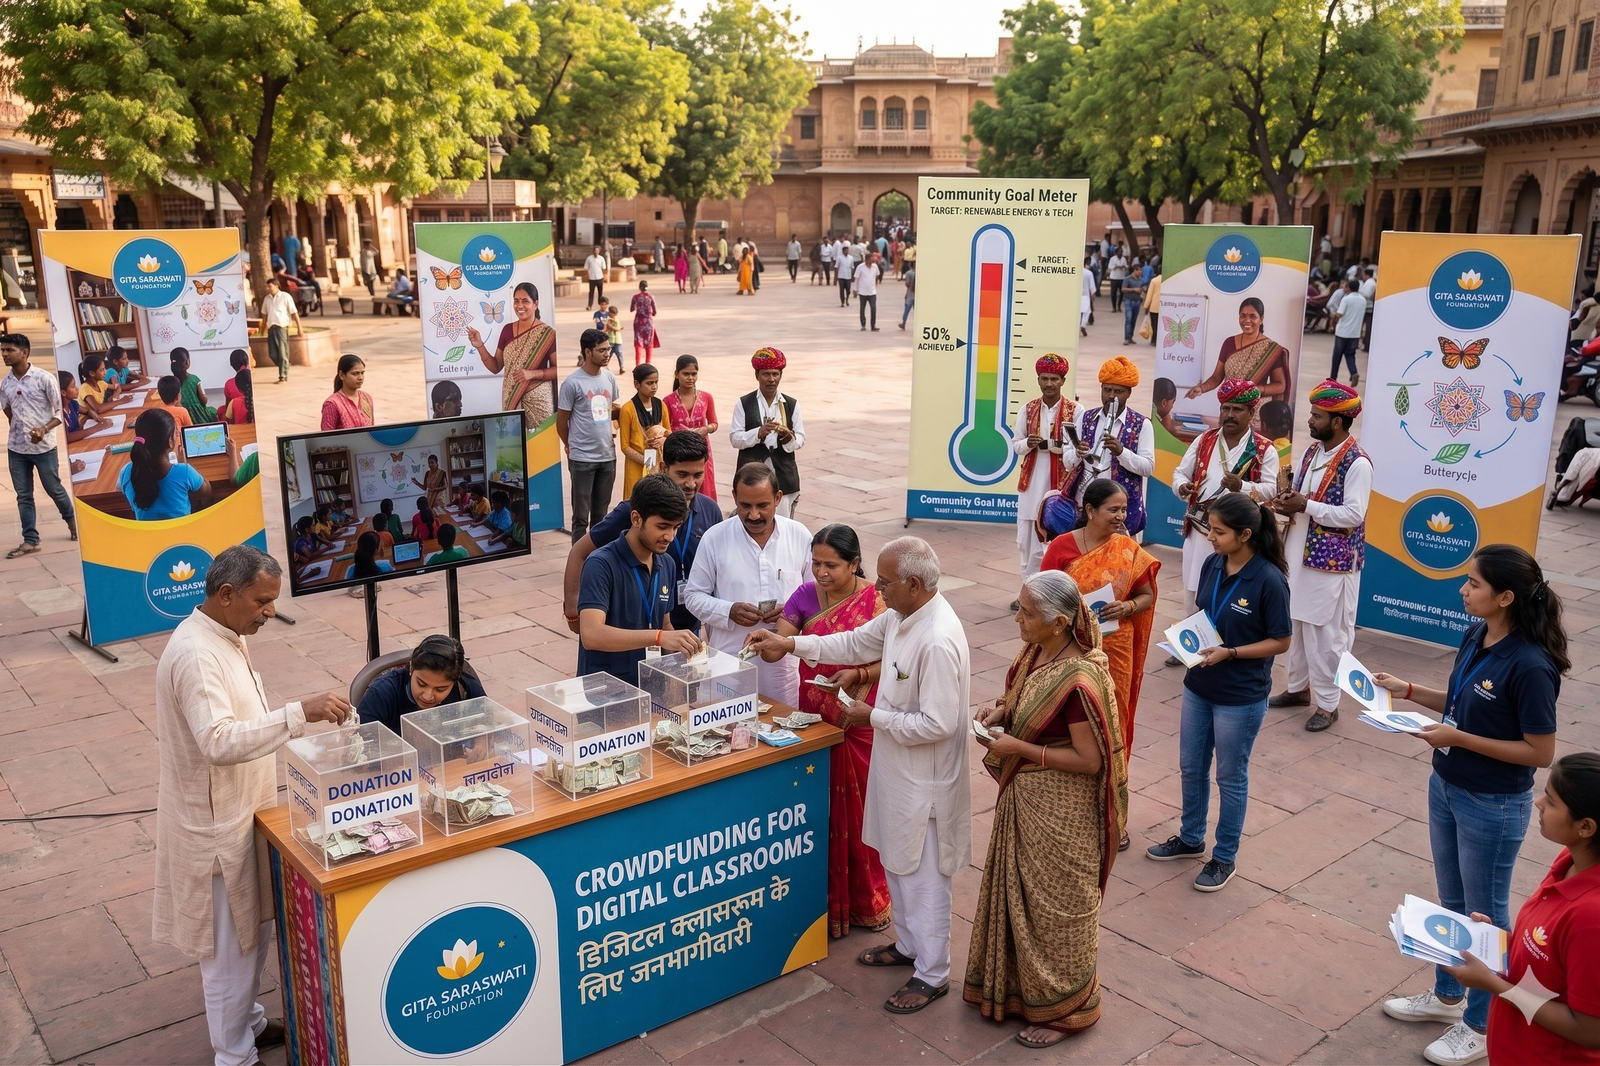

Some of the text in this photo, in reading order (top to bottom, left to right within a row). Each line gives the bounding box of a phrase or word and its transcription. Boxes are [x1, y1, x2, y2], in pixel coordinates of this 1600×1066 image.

[927, 187, 1078, 204] Community Goal Meter
[930, 206, 1073, 217] TARGET: RENEWABLE ENERGY & TECH
[1031, 256, 1076, 275] TARGET: RENEWABLE
[119, 275, 182, 284] GITA SARASWATI
[1434, 292, 1504, 302] GITA SARASWATI
[922, 327, 950, 341] 50%
[918, 343, 955, 352] ACHIEVED
[1163, 352, 1195, 364] Life cycle
[920, 495, 1019, 509] Community Goal Met
[1406, 530, 1471, 548] GITA SARASWATI
[1416, 540, 1459, 552] FOUNDATION
[153, 580, 206, 597] GITA SARASW
[163, 589, 205, 601] FOUNDATION
[1427, 605, 1442, 615] FOR
[693, 700, 753, 727] DONATION
[579, 730, 646, 759] DONATION
[328, 768, 412, 801] DONATION
[331, 792, 413, 825] DONATION
[575, 803, 807, 897] CROWDFUNDING FOR
[577, 830, 815, 932] DIGITAL CLASSROOMS
[577, 875, 791, 972] डिजिटल क्लासरूम के
[578, 917, 753, 1005] लिए जनभागीदारी
[401, 963, 527, 1018] GITA SARASWATI
[426, 988, 504, 1023] FOUNDATION
